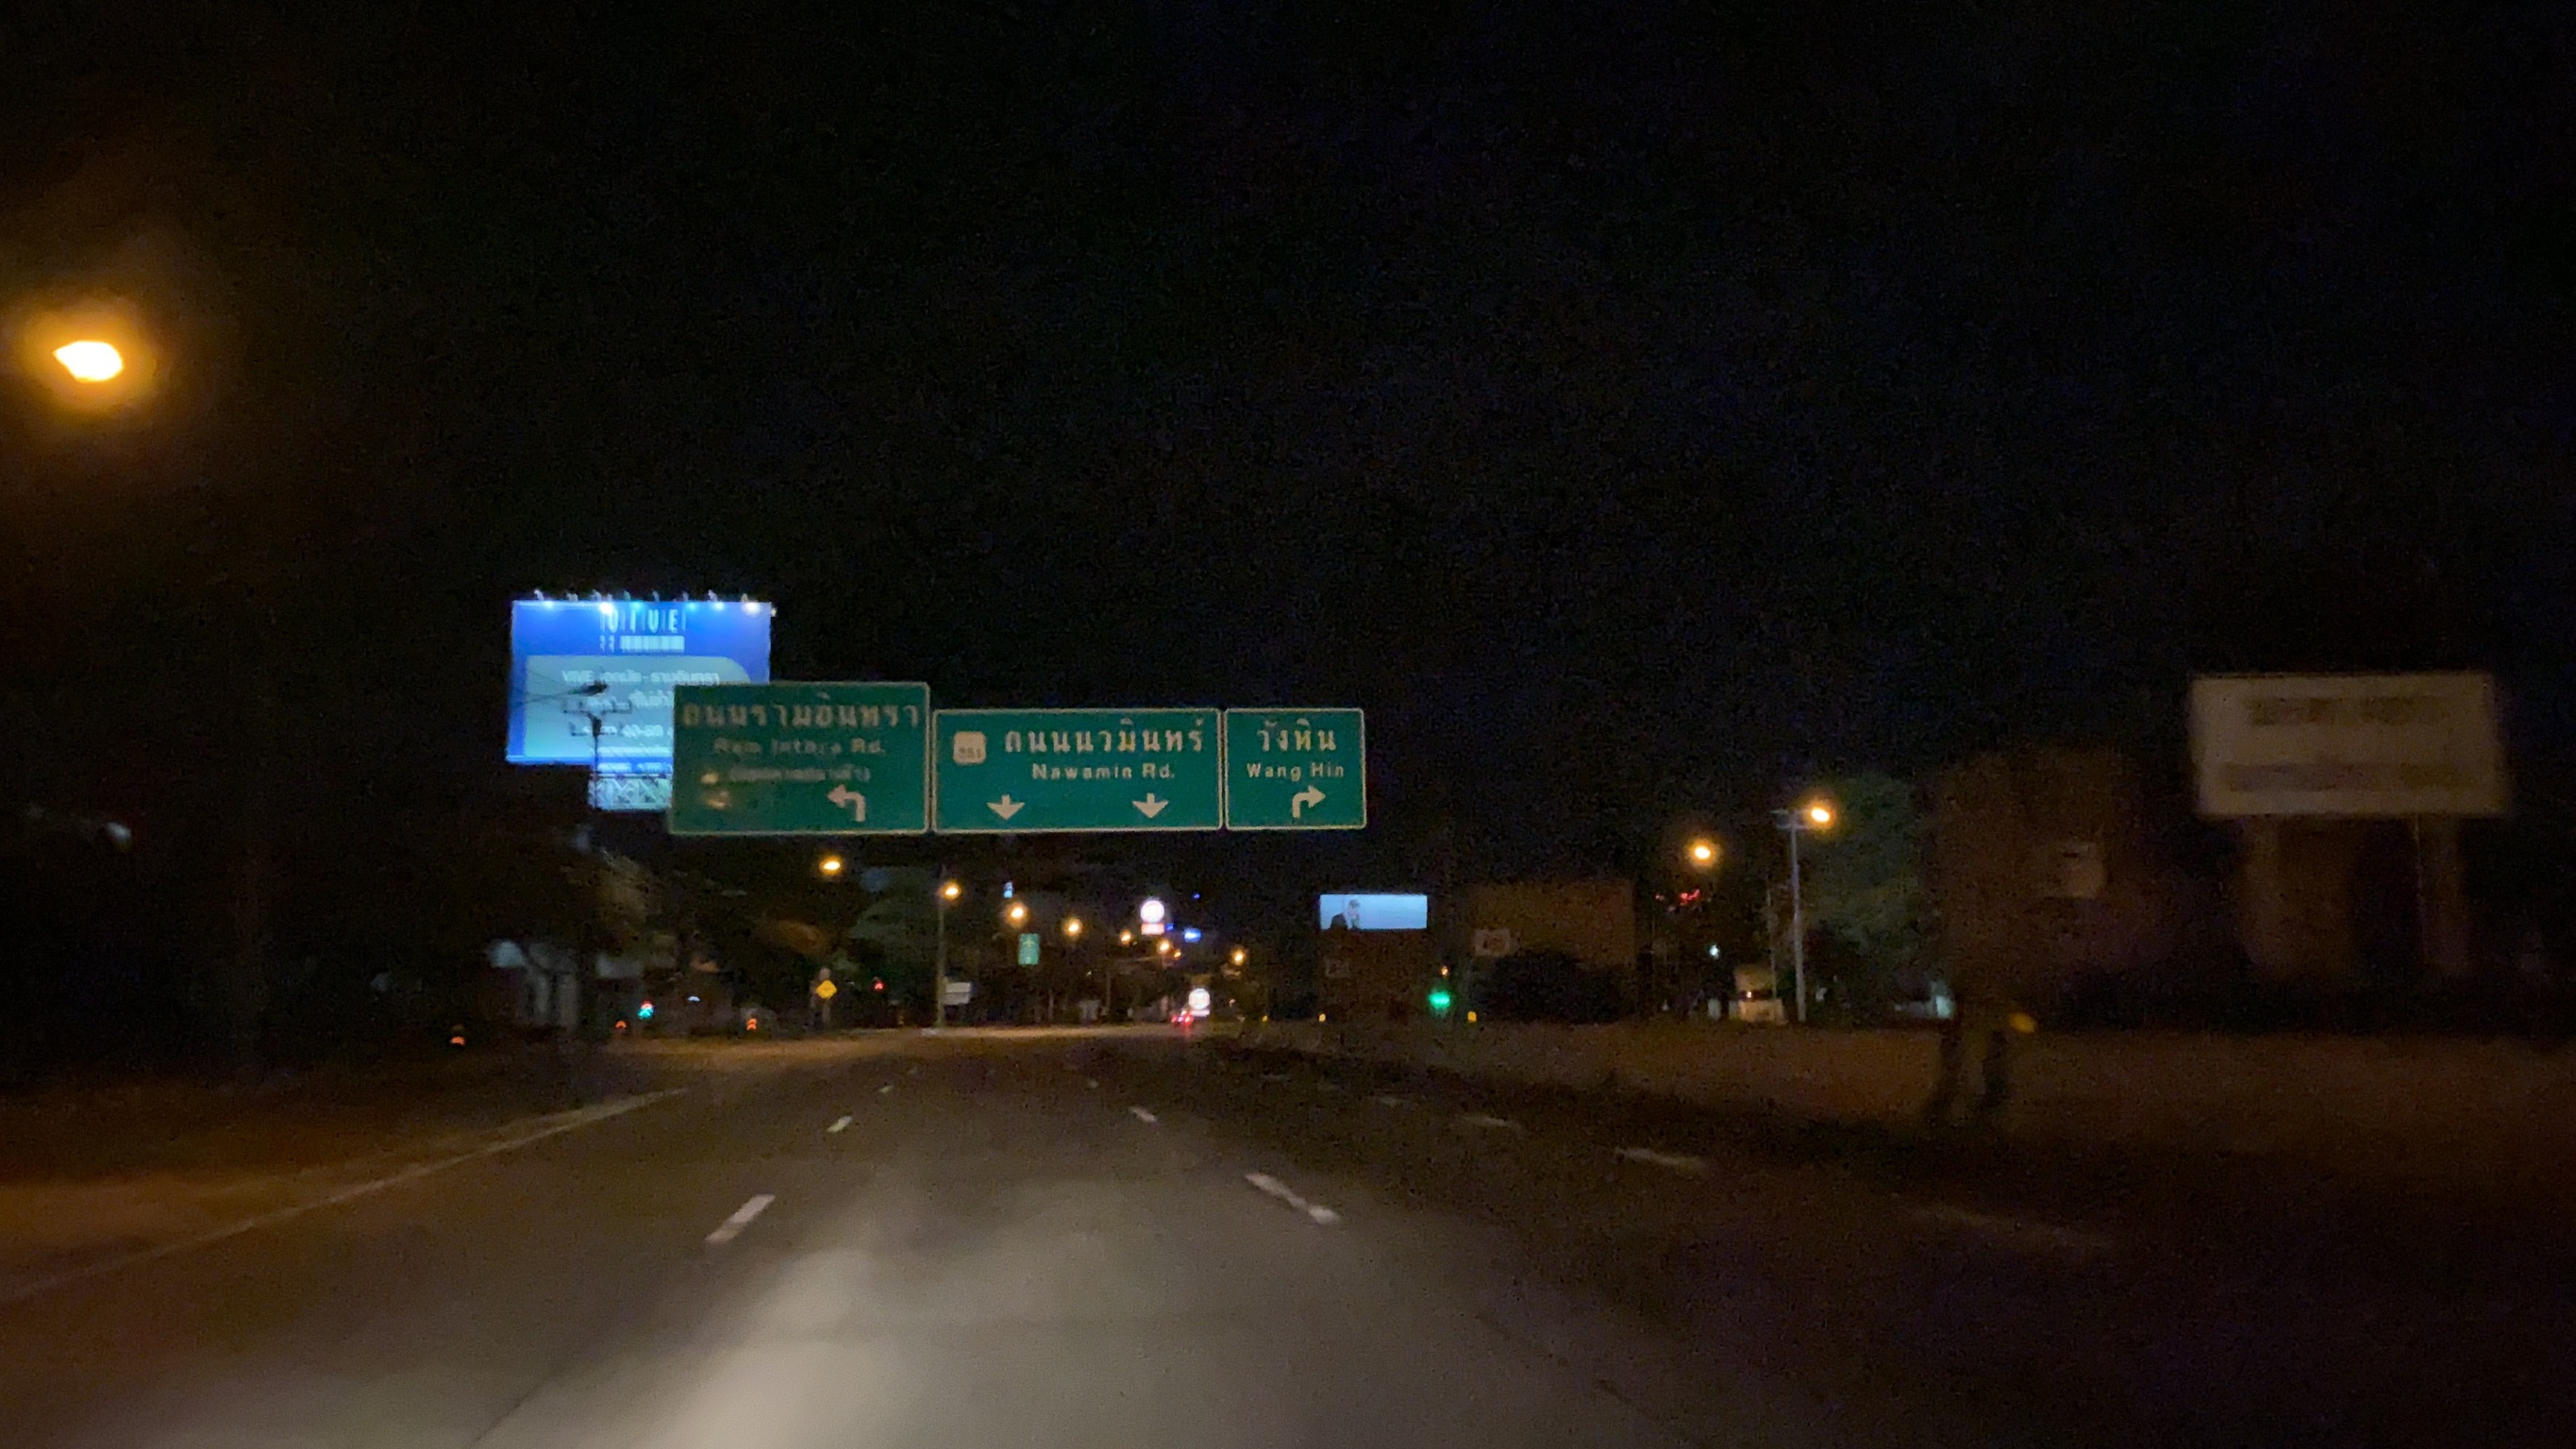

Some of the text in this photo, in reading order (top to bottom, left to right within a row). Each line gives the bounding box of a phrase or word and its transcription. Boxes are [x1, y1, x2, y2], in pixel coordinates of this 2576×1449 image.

[1004, 718, 1204, 753] ถนนนวมินทร์
[1257, 718, 1337, 752] วังหิน
[1032, 763, 1175, 780] Nawamin Rd.
[1246, 762, 1344, 782] Wang Hin
